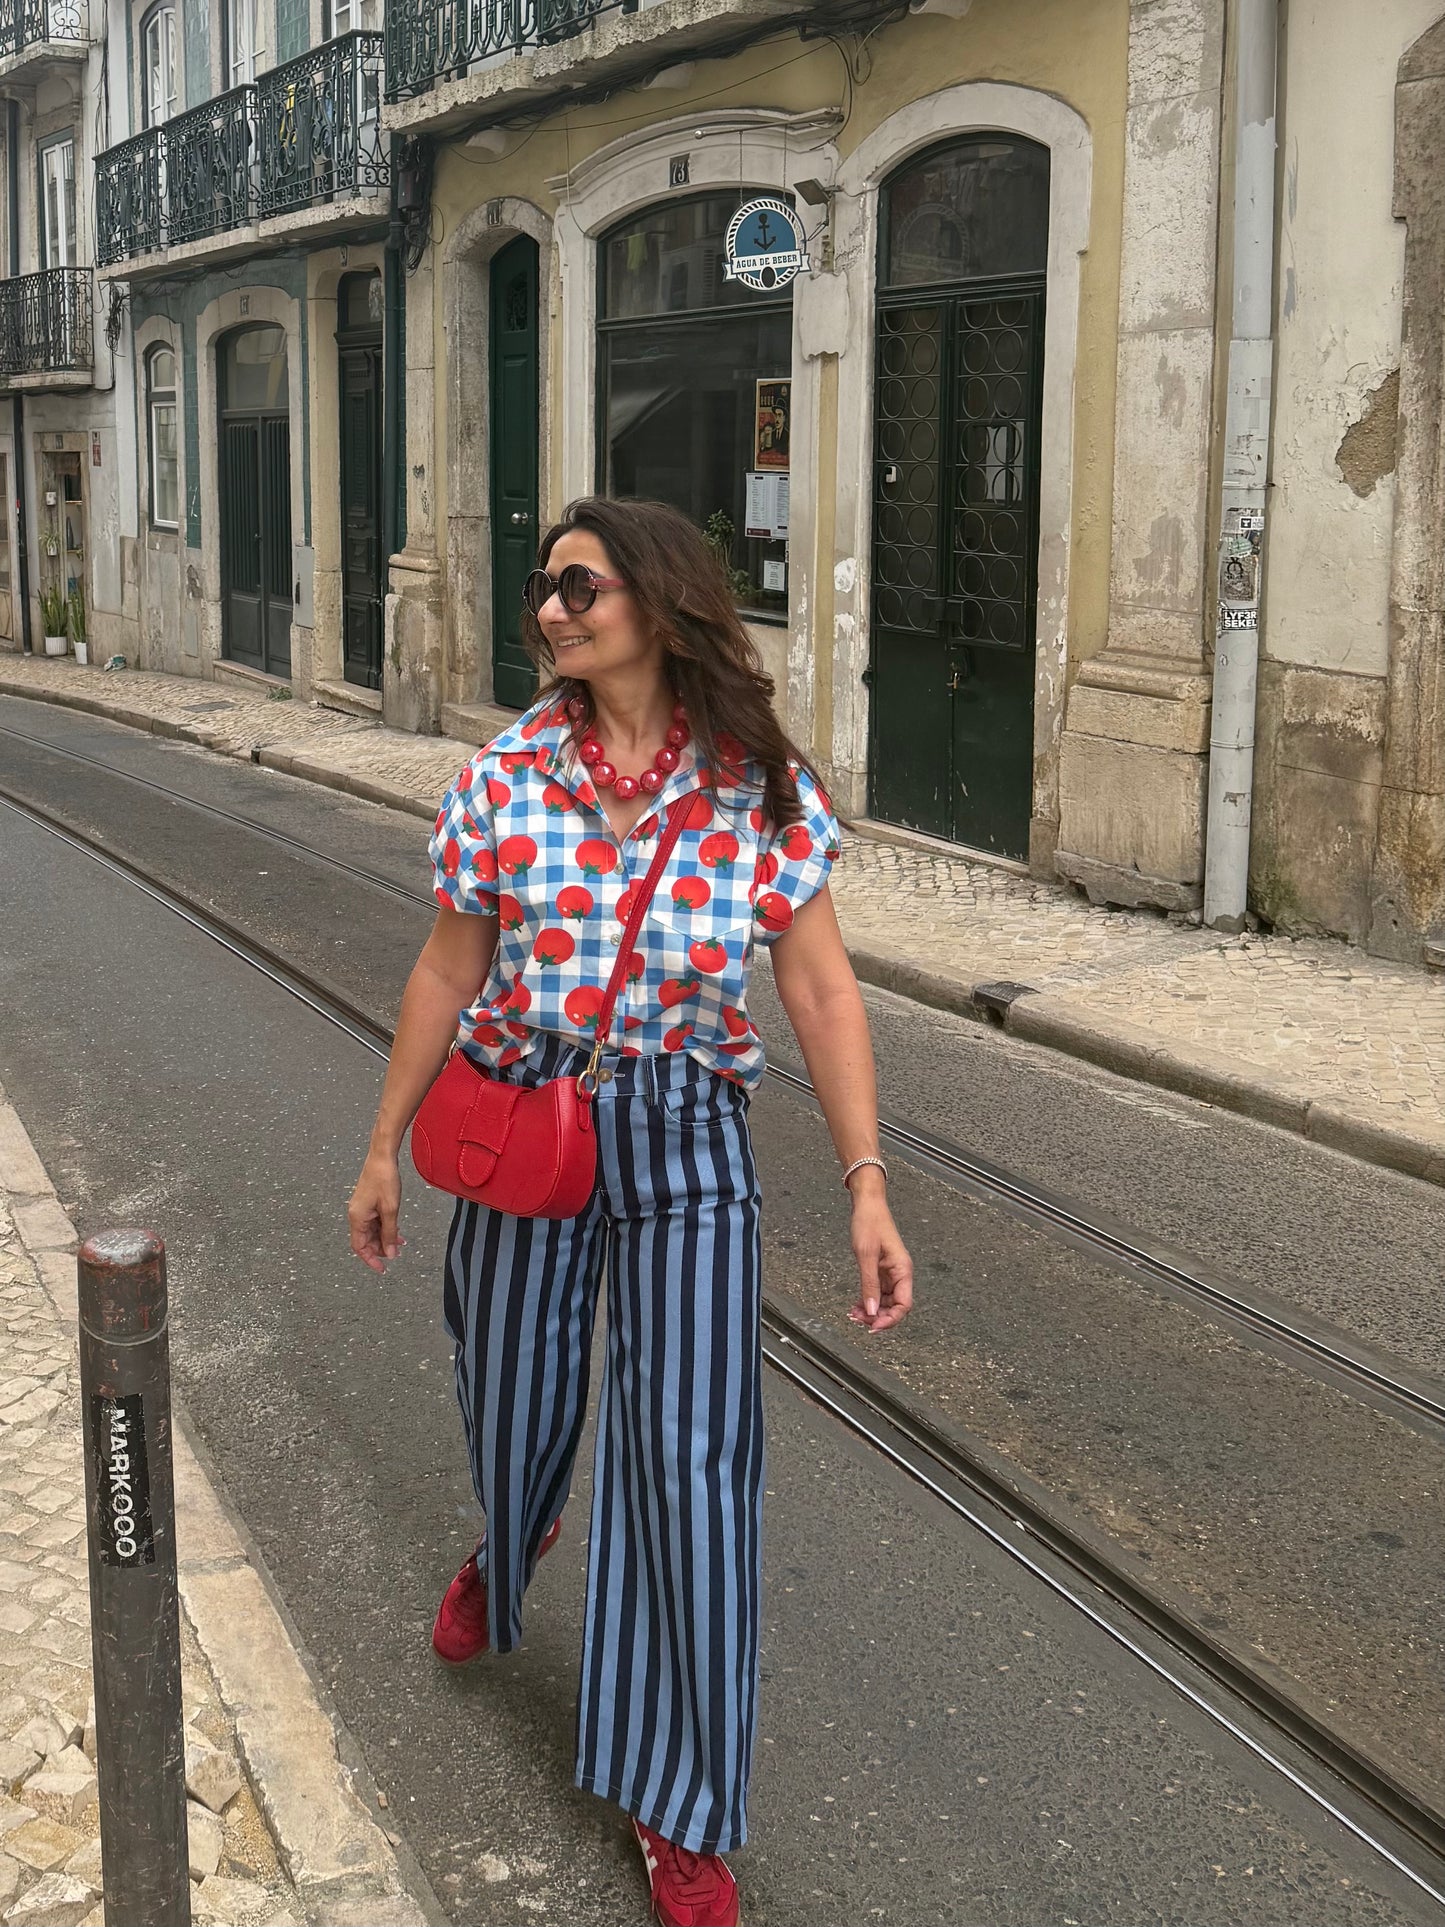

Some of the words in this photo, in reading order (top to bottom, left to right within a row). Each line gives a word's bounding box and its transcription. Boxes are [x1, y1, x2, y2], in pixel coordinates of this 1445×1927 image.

[736, 258, 757, 269] AGUA
[759, 257, 770, 266] DE
[772, 254, 798, 265] BEBER
[1224, 611, 1257, 620] LYF3R
[1224, 619, 1257, 628] SEKEL
[108, 1408, 137, 1558] MARKOOO
